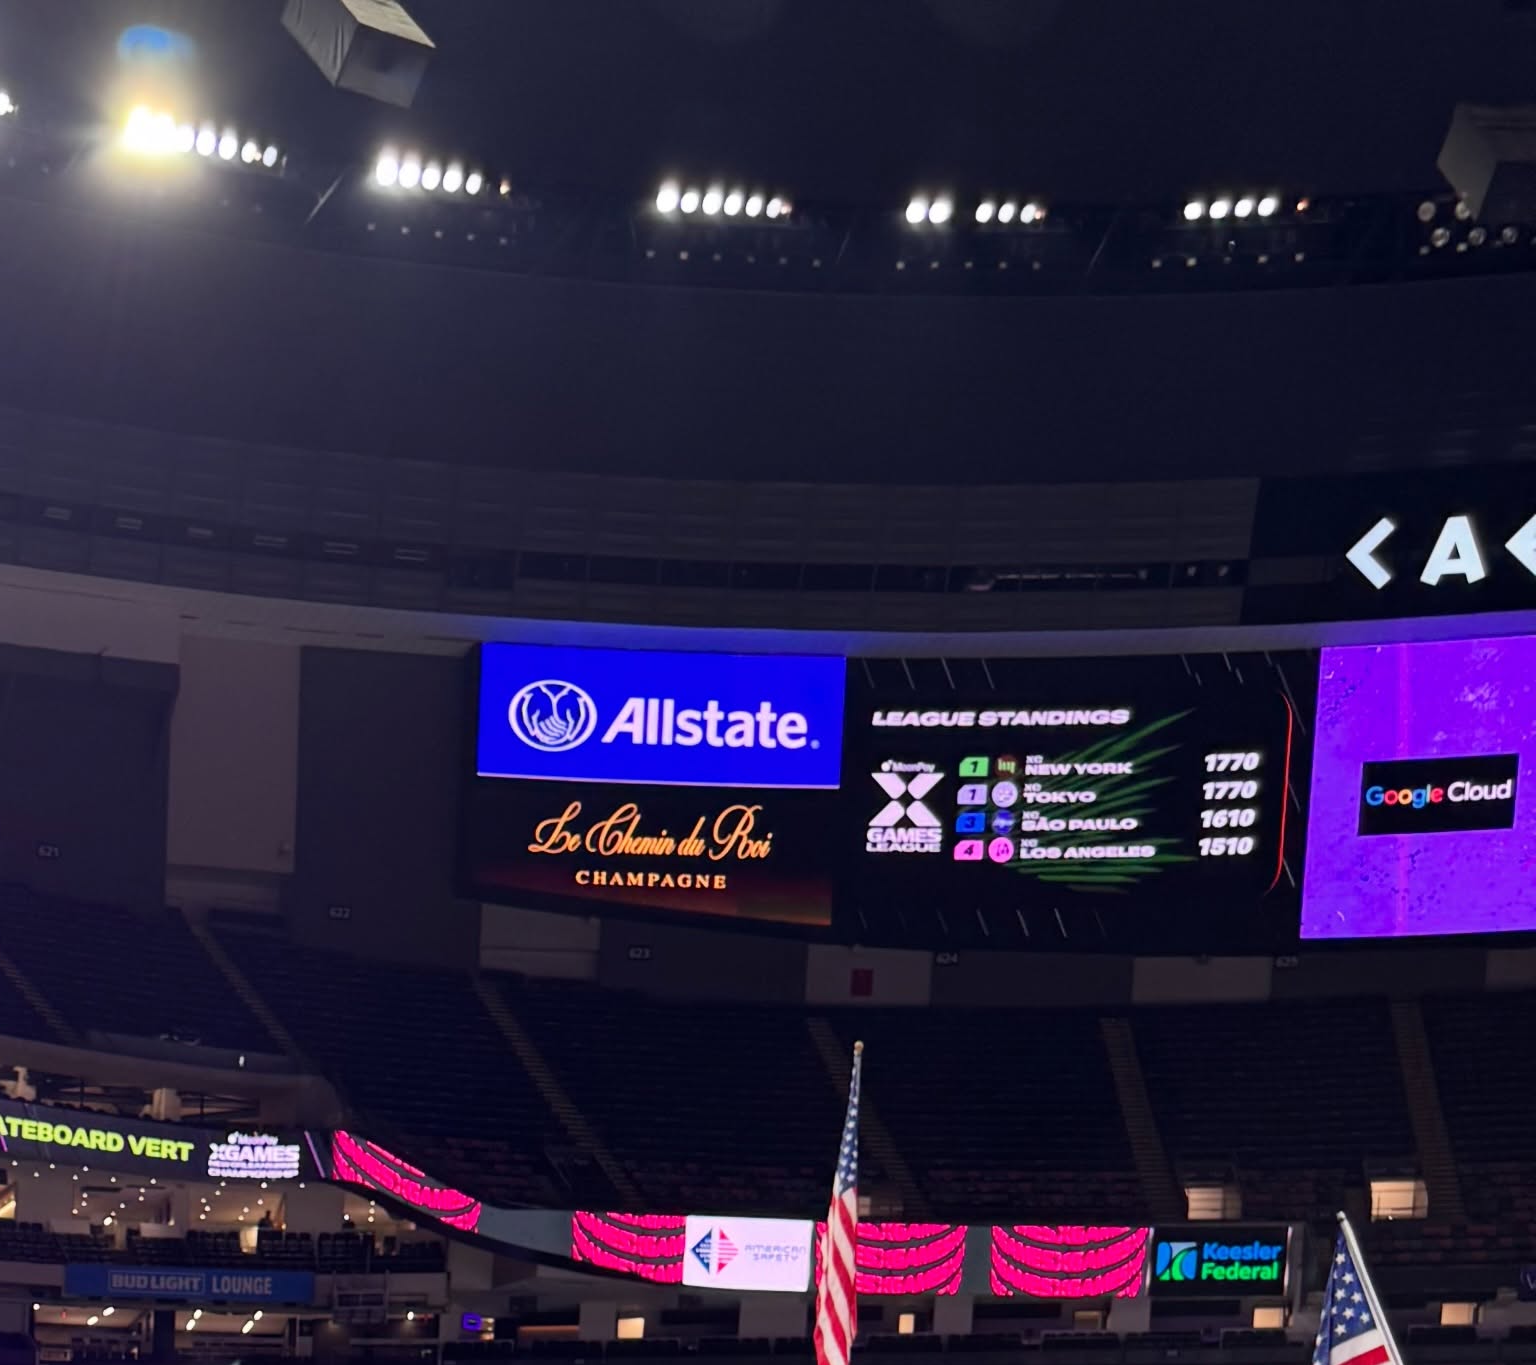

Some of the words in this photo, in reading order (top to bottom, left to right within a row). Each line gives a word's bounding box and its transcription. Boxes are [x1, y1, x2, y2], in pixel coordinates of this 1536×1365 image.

[600, 696, 810, 750] Allstate
[872, 711, 976, 727] LEAGUE
[978, 709, 1131, 727] STANDINGS
[1025, 762, 1072, 776] NEW
[1074, 761, 1133, 776] YORK
[1203, 751, 1261, 773] 1770
[1022, 791, 1096, 804] TOKYO
[1201, 779, 1259, 801] 1770
[1365, 784, 1444, 809] Google
[1447, 778, 1513, 803] Cloud
[1070, 817, 1138, 831] PAULO
[1199, 807, 1256, 829] 1610
[527, 800, 582, 855] Le
[584, 802, 676, 858] Chemin
[677, 815, 706, 859] du
[708, 803, 773, 861] Roi
[866, 827, 943, 844] GAMES
[865, 843, 942, 853] LEAGUE
[1019, 845, 1061, 859] LOS
[1063, 844, 1156, 859] ANGELES
[1197, 836, 1254, 857] 1510
[575, 869, 727, 890] CHAMPAGNE
[126, 1133, 195, 1163] VERT
[1203, 1240, 1283, 1260] Keesler
[1201, 1261, 1279, 1280] Federal
[111, 1274, 149, 1289] BUD
[151, 1275, 202, 1291] LIGHT
[212, 1276, 273, 1295] LOUNGE
